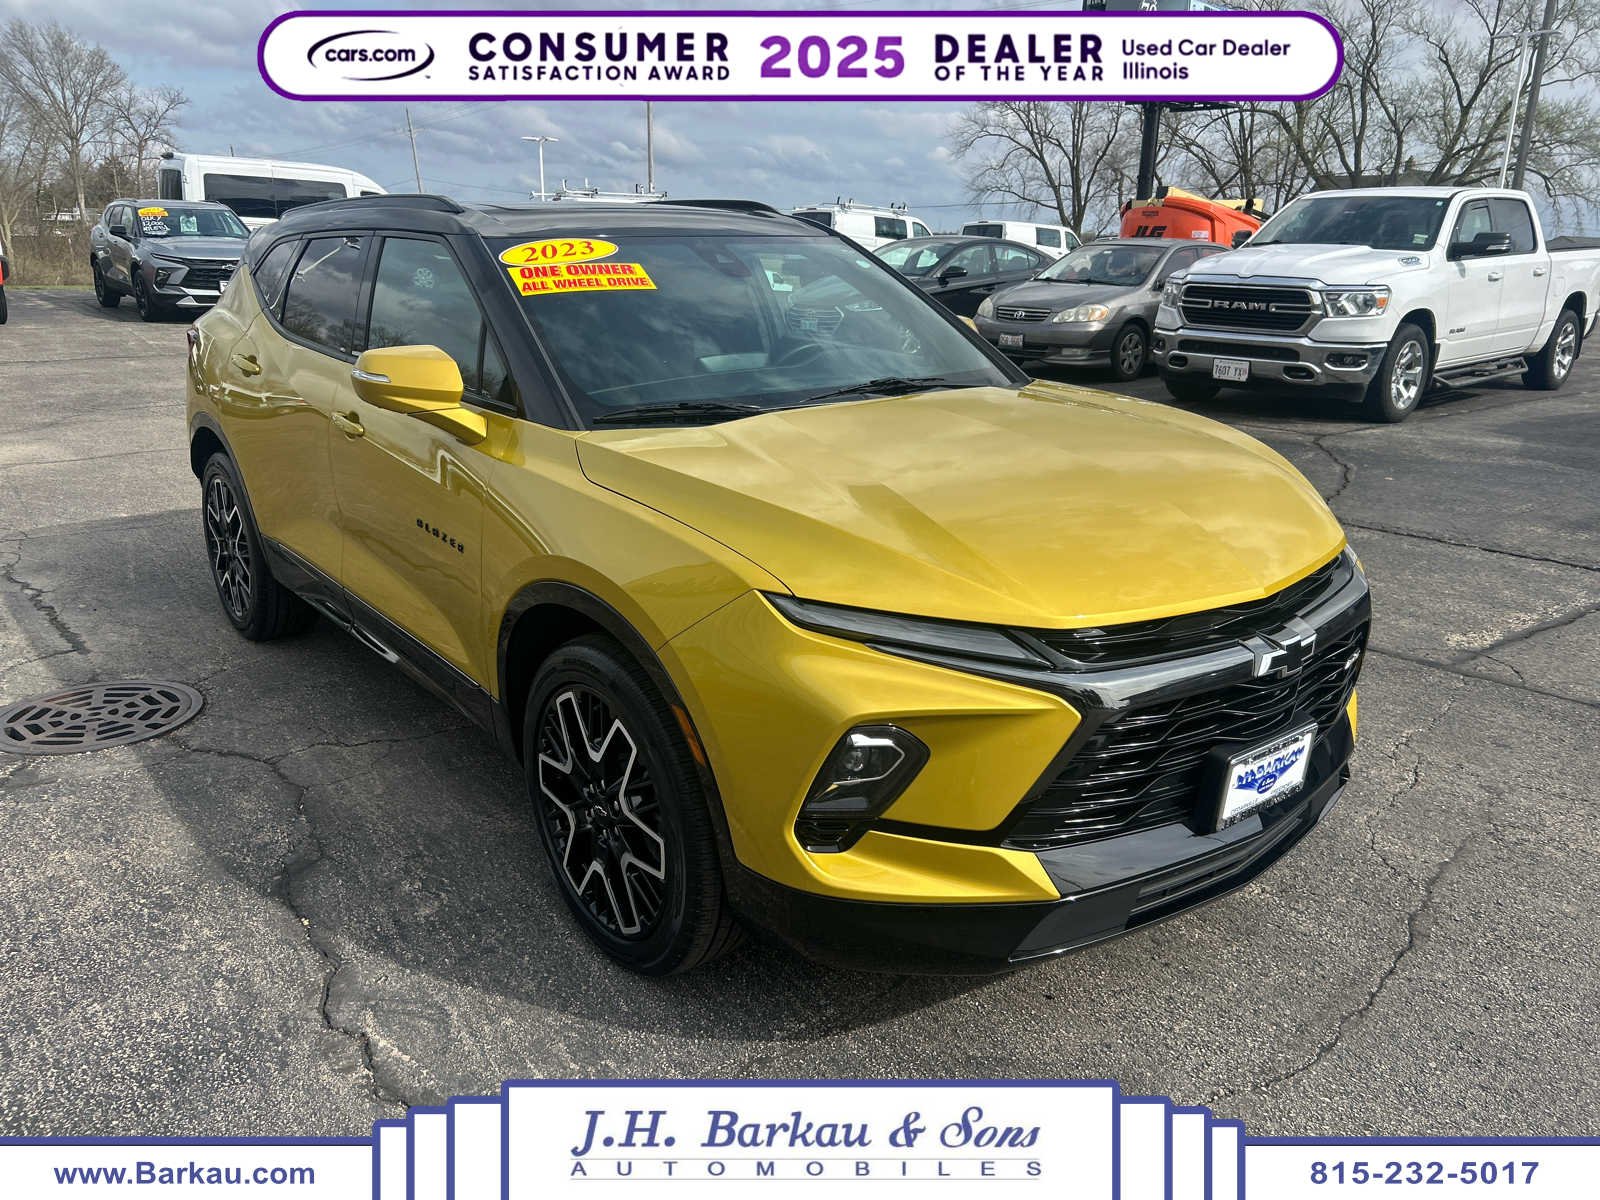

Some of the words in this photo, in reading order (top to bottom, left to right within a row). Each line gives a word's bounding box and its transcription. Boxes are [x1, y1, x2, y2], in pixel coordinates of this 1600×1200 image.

[1132, 225, 1167, 238] JLG
[521, 240, 595, 263] 2023
[519, 265, 561, 279] ONE
[566, 264, 634, 276] OWNER
[521, 281, 549, 292] ALL
[554, 278, 603, 289] WHEEL
[607, 276, 650, 287] DRIVE
[1213, 300, 1267, 311] RAM
[416, 518, 464, 554] BLAZER
